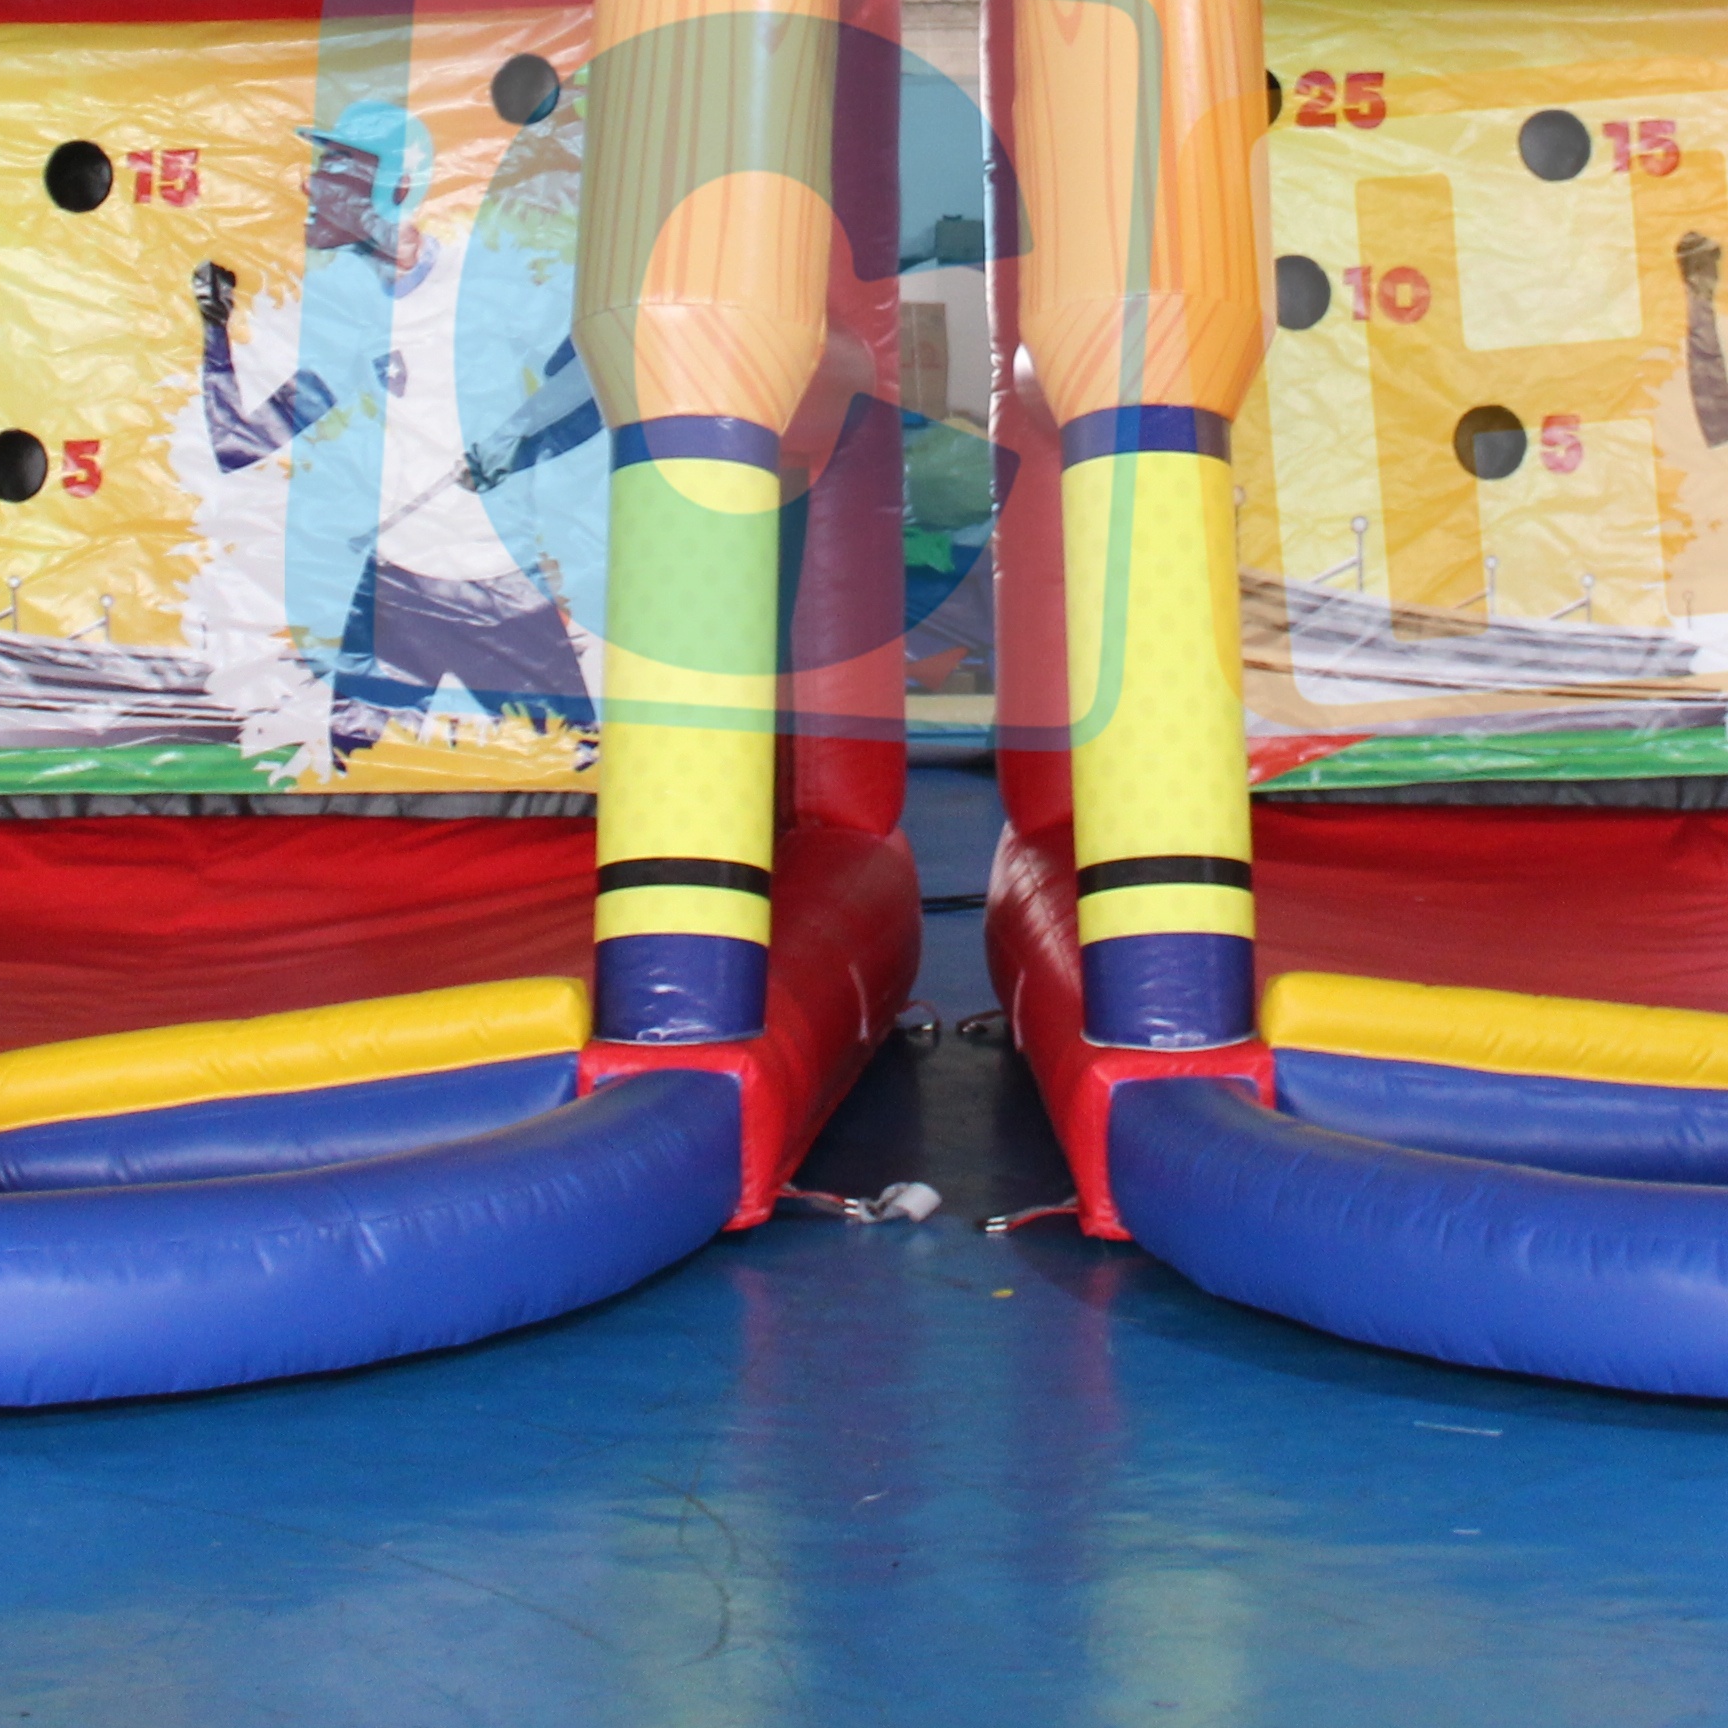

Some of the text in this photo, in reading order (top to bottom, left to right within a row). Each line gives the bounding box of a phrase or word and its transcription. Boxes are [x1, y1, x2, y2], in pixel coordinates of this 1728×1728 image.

[1295, 69, 1386, 130] 25
[1602, 119, 1681, 176] 15
[125, 148, 202, 208] 15
[1343, 265, 1431, 324] 10
[61, 439, 104, 499] 5
[1541, 415, 1584, 474] 5
